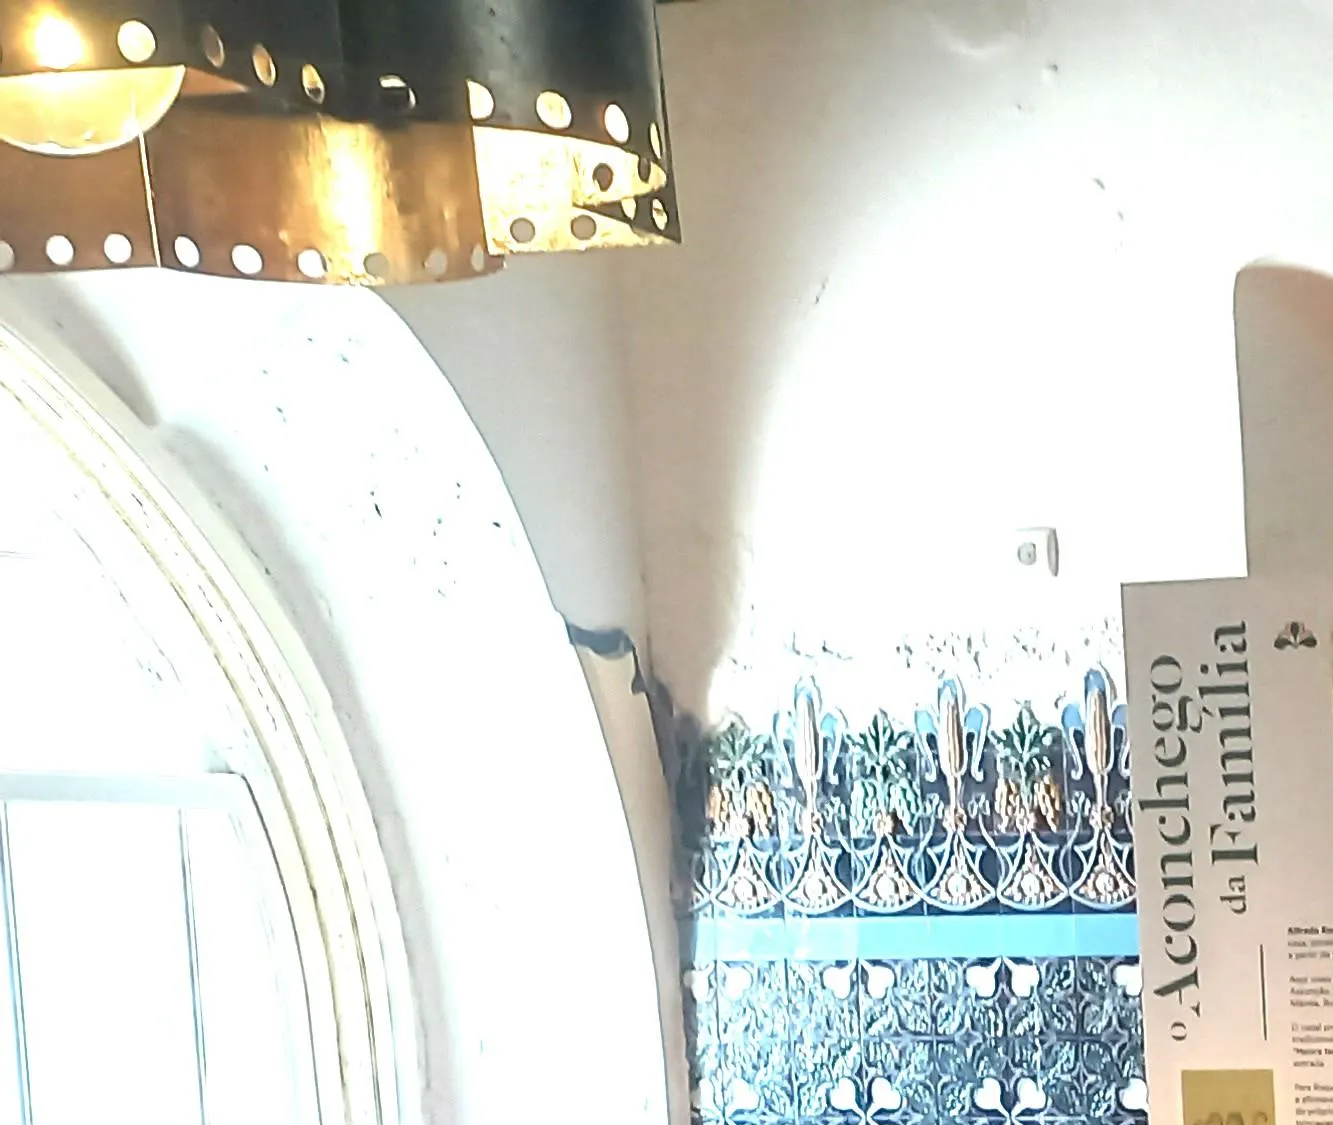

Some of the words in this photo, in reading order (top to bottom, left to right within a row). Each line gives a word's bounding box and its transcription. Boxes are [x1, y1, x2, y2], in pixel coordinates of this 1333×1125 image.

[1198, 620, 1258, 866] Família
[1139, 654, 1202, 1018] Aconchego
[1219, 875, 1248, 915] da
[1170, 1022, 1188, 1042] o
